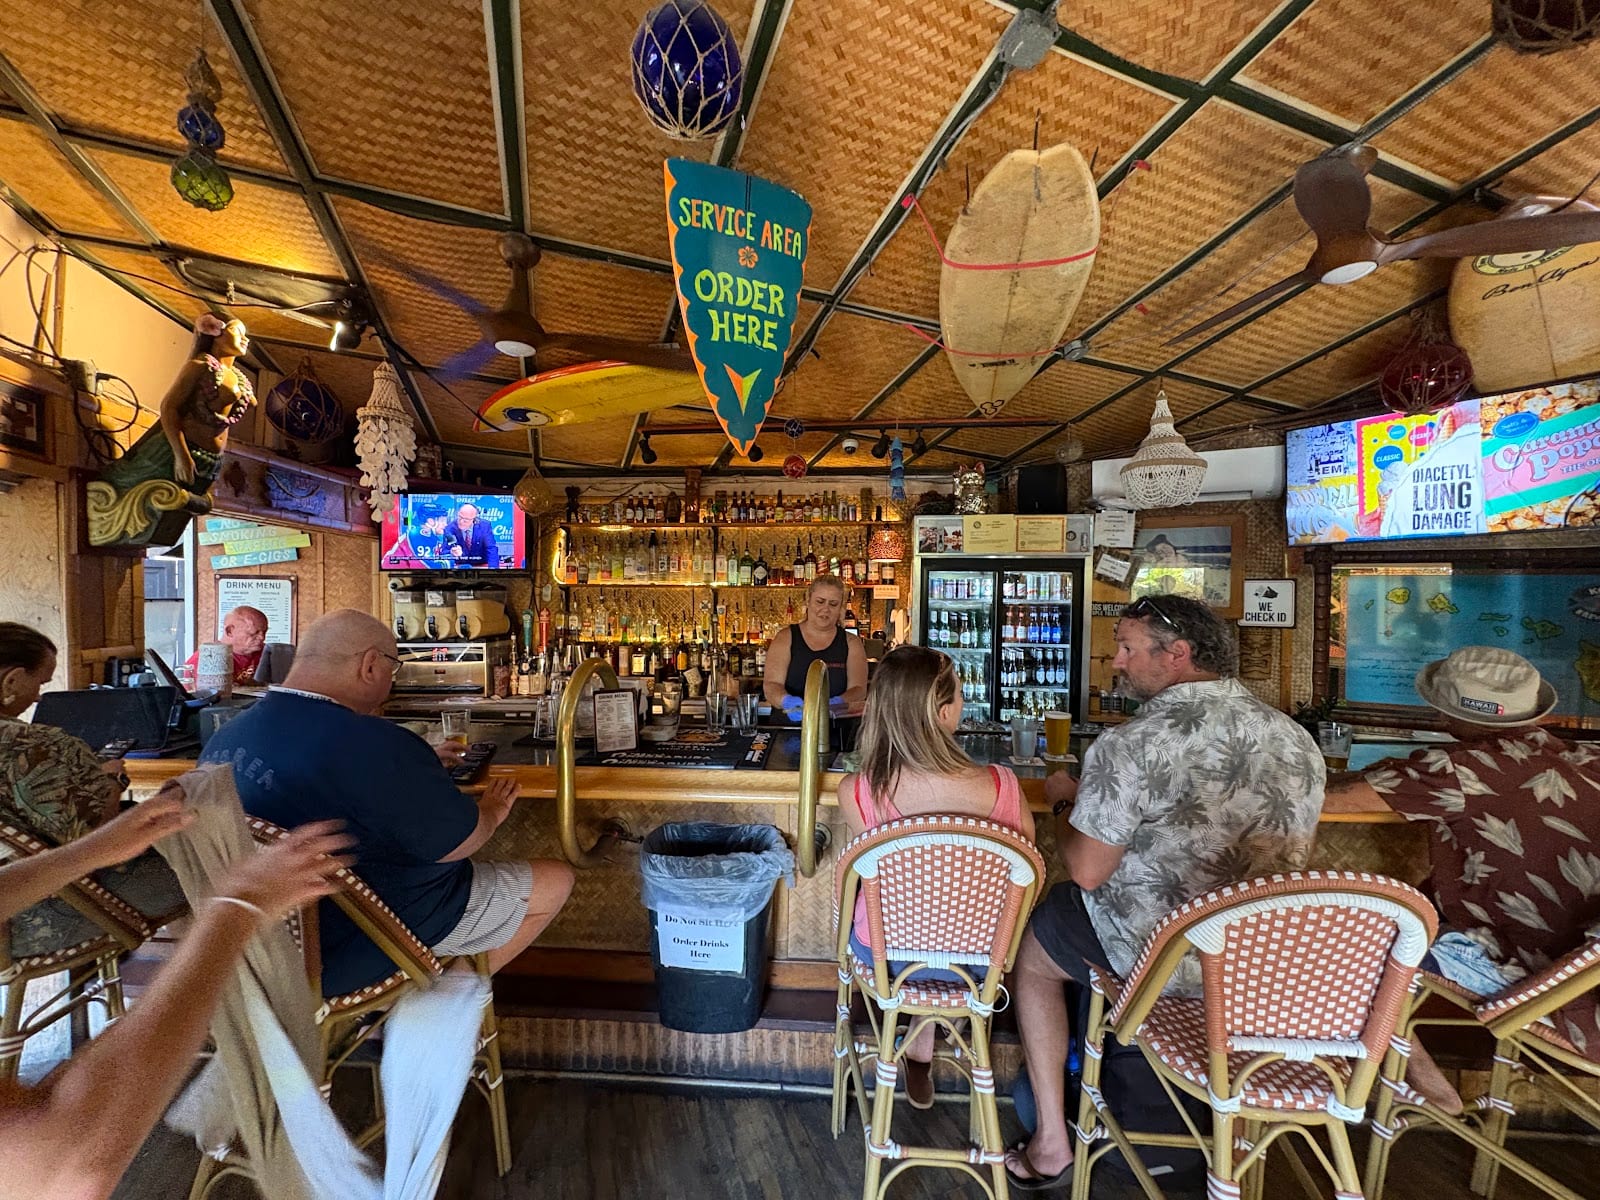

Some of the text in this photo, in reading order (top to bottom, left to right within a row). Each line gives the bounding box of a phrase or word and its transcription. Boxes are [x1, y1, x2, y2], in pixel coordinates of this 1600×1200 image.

[678, 197, 802, 260] SERVICE AREA
[694, 269, 785, 317] ORDER
[708, 309, 778, 352] HERE
[1376, 453, 1401, 462] CLASSIC
[1413, 481, 1472, 512] LUNG
[1412, 511, 1472, 530] DAMAGE
[210, 527, 277, 543] SMOKING
[417, 545, 431, 557] 92
[219, 550, 291, 567] OR E-CIGS
[226, 581, 281, 590] DRINK MENU
[1258, 602, 1273, 612] WE
[1245, 611, 1287, 622] CHECK ID
[665, 914, 678, 923] Do
[680, 917, 697, 925] Not
[698, 919, 713, 927] Sit
[673, 937, 729, 948] Order Drinks
[690, 950, 711, 958] Here
